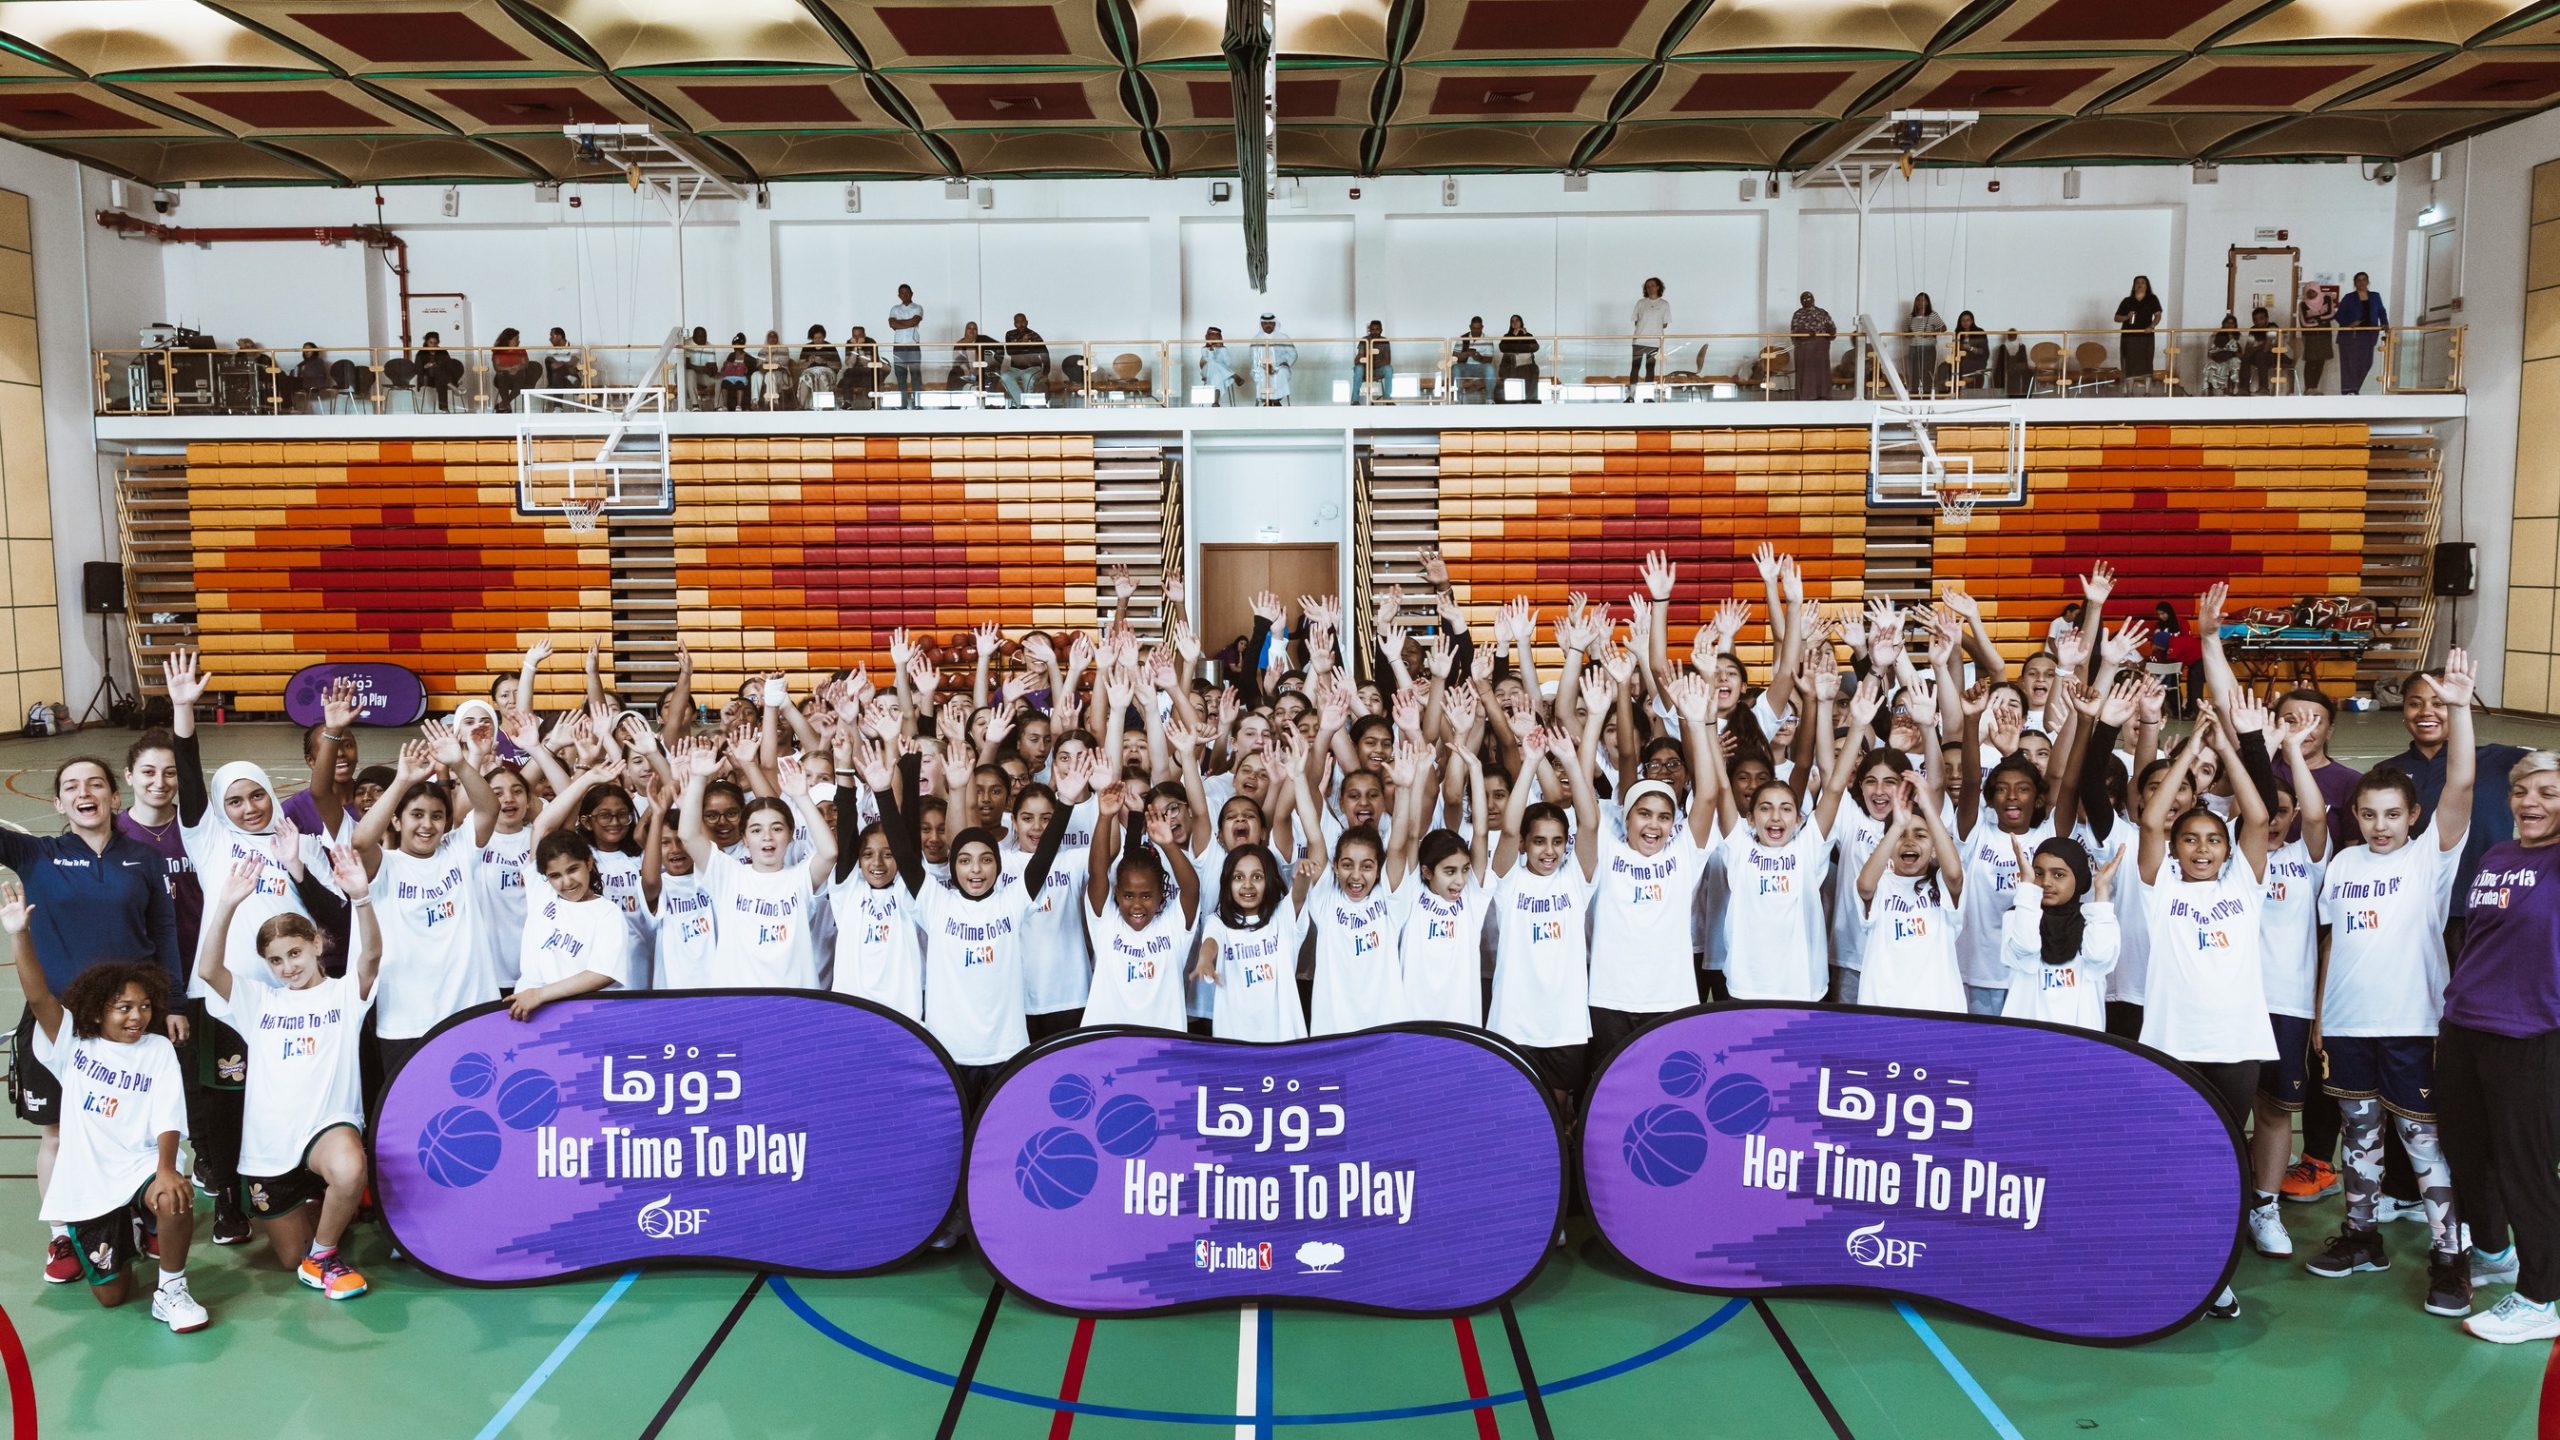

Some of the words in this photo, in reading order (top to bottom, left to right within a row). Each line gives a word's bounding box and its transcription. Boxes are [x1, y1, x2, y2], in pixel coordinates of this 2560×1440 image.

[369, 692, 388, 708] Play
[1079, 830, 1090, 845] To
[165, 857, 180, 873] To
[1630, 863, 1651, 881] ime
[1652, 863, 1665, 879] To
[501, 870, 511, 890] jr.
[1047, 875, 1053, 888] o
[1760, 875, 1771, 895] jr.
[1996, 872, 2006, 892] jr.
[2342, 881, 2370, 899] Time
[2373, 879, 2386, 897] To
[398, 881, 417, 900] Her
[672, 897, 697, 914] Time
[736, 893, 752, 913] Her
[755, 898, 779, 917] Time
[780, 899, 791, 917] To
[1531, 896, 1550, 914] ime
[2170, 899, 2189, 917] Her
[426, 907, 438, 927] jr.
[2346, 911, 2357, 934] jr.
[758, 924, 769, 945] jr.
[960, 922, 984, 941] Time
[986, 922, 997, 940] To
[1428, 919, 1439, 940] jr.
[1533, 922, 1543, 944] jr.
[1895, 918, 1906, 941] jr.
[2198, 927, 2210, 950] jr.
[560, 933, 584, 958] Play
[1235, 940, 1260, 960] Time
[1355, 935, 1366, 956] jr.
[965, 947, 976, 967] jr.
[1128, 962, 1138, 983] jr.
[1244, 966, 1256, 987] jr.
[2043, 968, 2055, 990] jr.
[277, 1015, 305, 1030] Time
[308, 1013, 321, 1029] To
[282, 1038, 294, 1060] jr.
[87, 1059, 117, 1085] Time
[118, 1069, 131, 1090] To
[537, 1126, 594, 1178] Her
[602, 1126, 683, 1179] Time
[690, 1125, 728, 1178] To
[736, 1123, 807, 1182] Play
[1123, 1158, 1185, 1217] Her
[1193, 1162, 1280, 1222] Time
[1289, 1163, 1328, 1221] To
[1338, 1161, 1415, 1224] Play
[1742, 1133, 1805, 1192] Her
[1813, 1141, 1901, 1206] Time
[1911, 1152, 1952, 1211] To
[1961, 1157, 2046, 1230] Play
[1208, 1240, 1257, 1273] jr.nba
